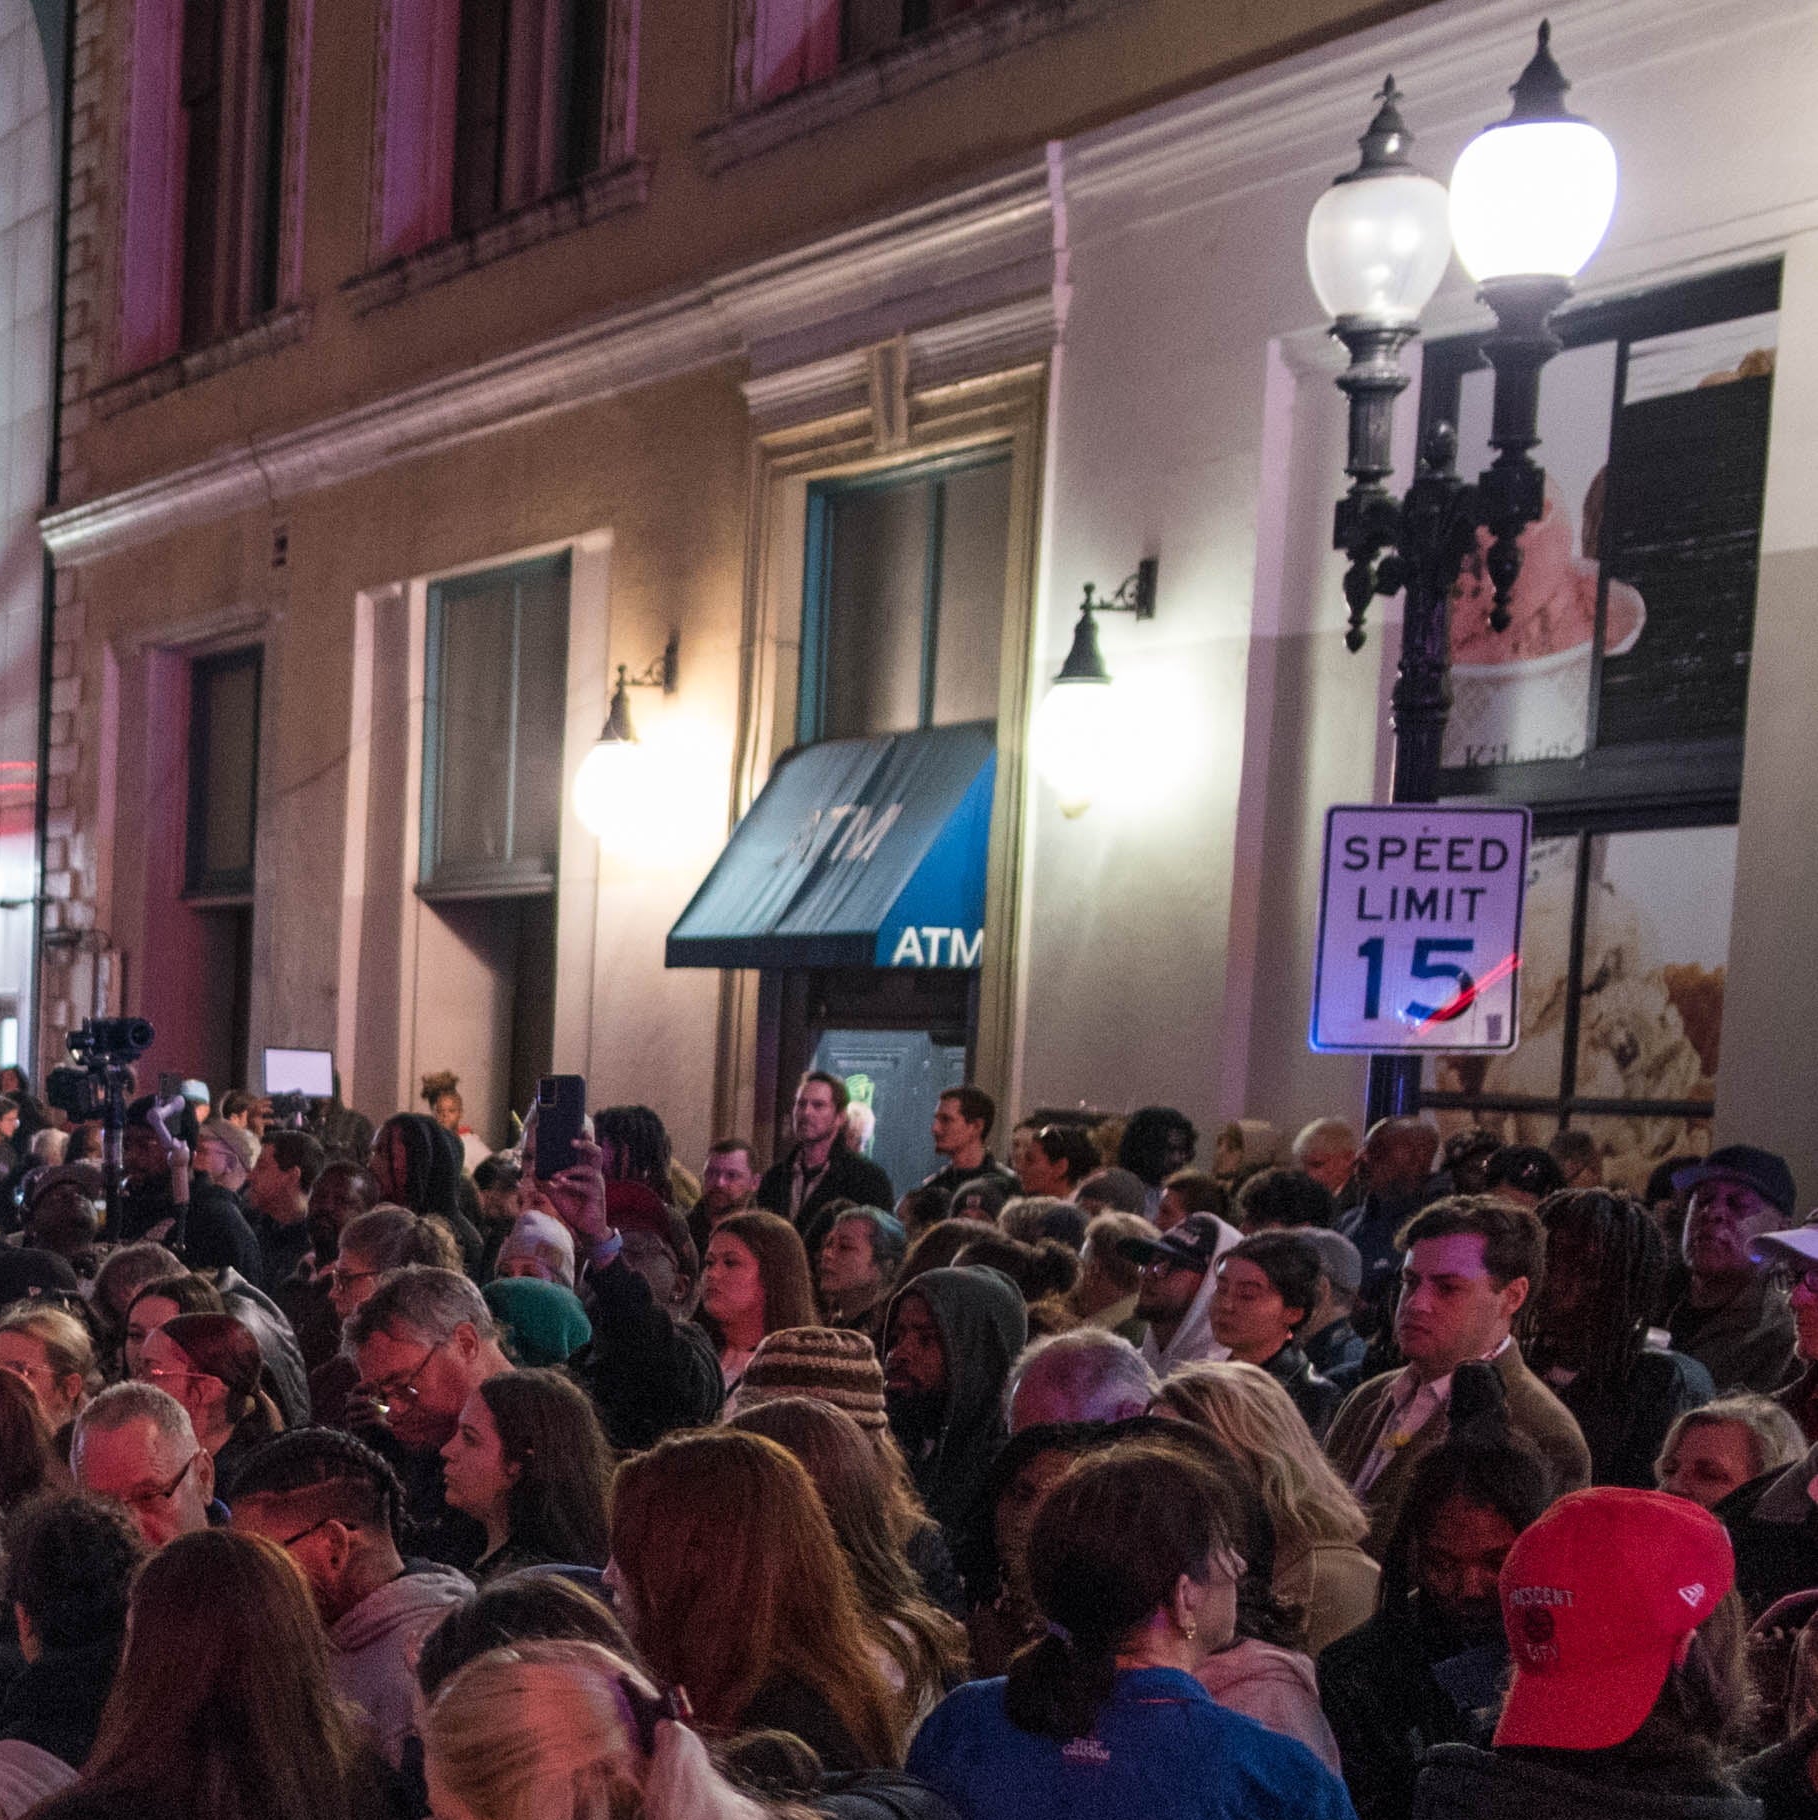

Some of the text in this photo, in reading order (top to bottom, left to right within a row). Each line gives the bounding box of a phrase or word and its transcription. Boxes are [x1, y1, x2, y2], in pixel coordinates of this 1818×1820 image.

[1342, 836, 1511, 872] SPEED
[1356, 886, 1488, 923] LIMIT
[891, 926, 984, 968] ATM
[1356, 936, 1477, 1022] 15
